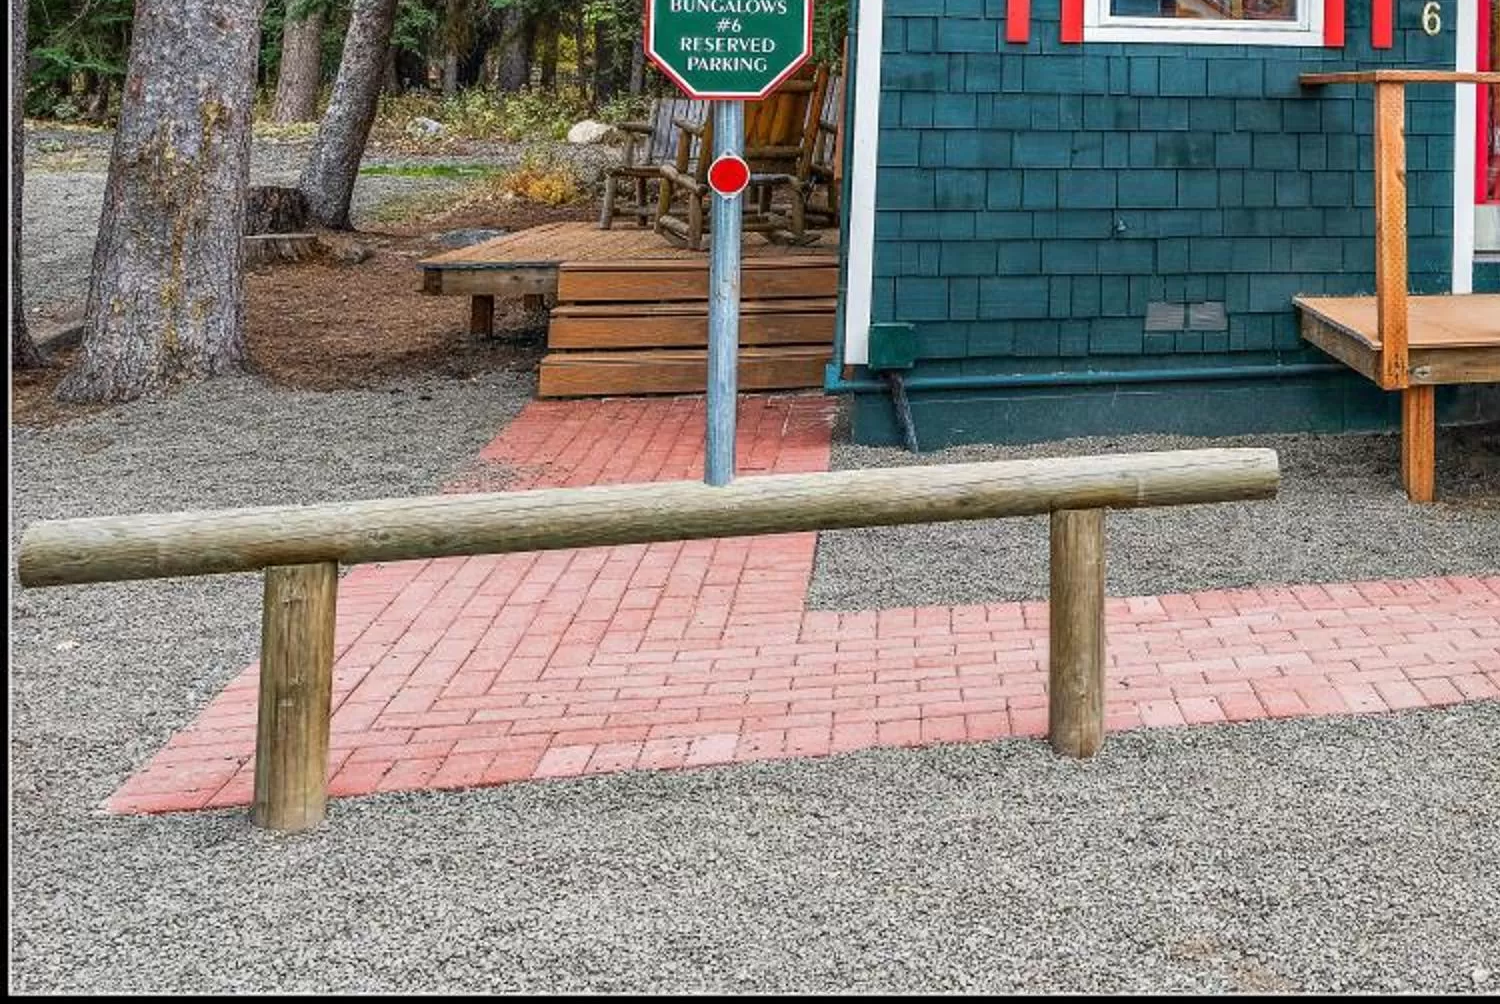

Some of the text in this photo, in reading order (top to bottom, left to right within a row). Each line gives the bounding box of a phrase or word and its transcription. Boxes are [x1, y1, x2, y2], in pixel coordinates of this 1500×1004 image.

[716, 18, 742, 33] #6
[1423, 1, 1441, 36] 6
[680, 37, 776, 53] RESERVED
[687, 56, 768, 73] PARKING
